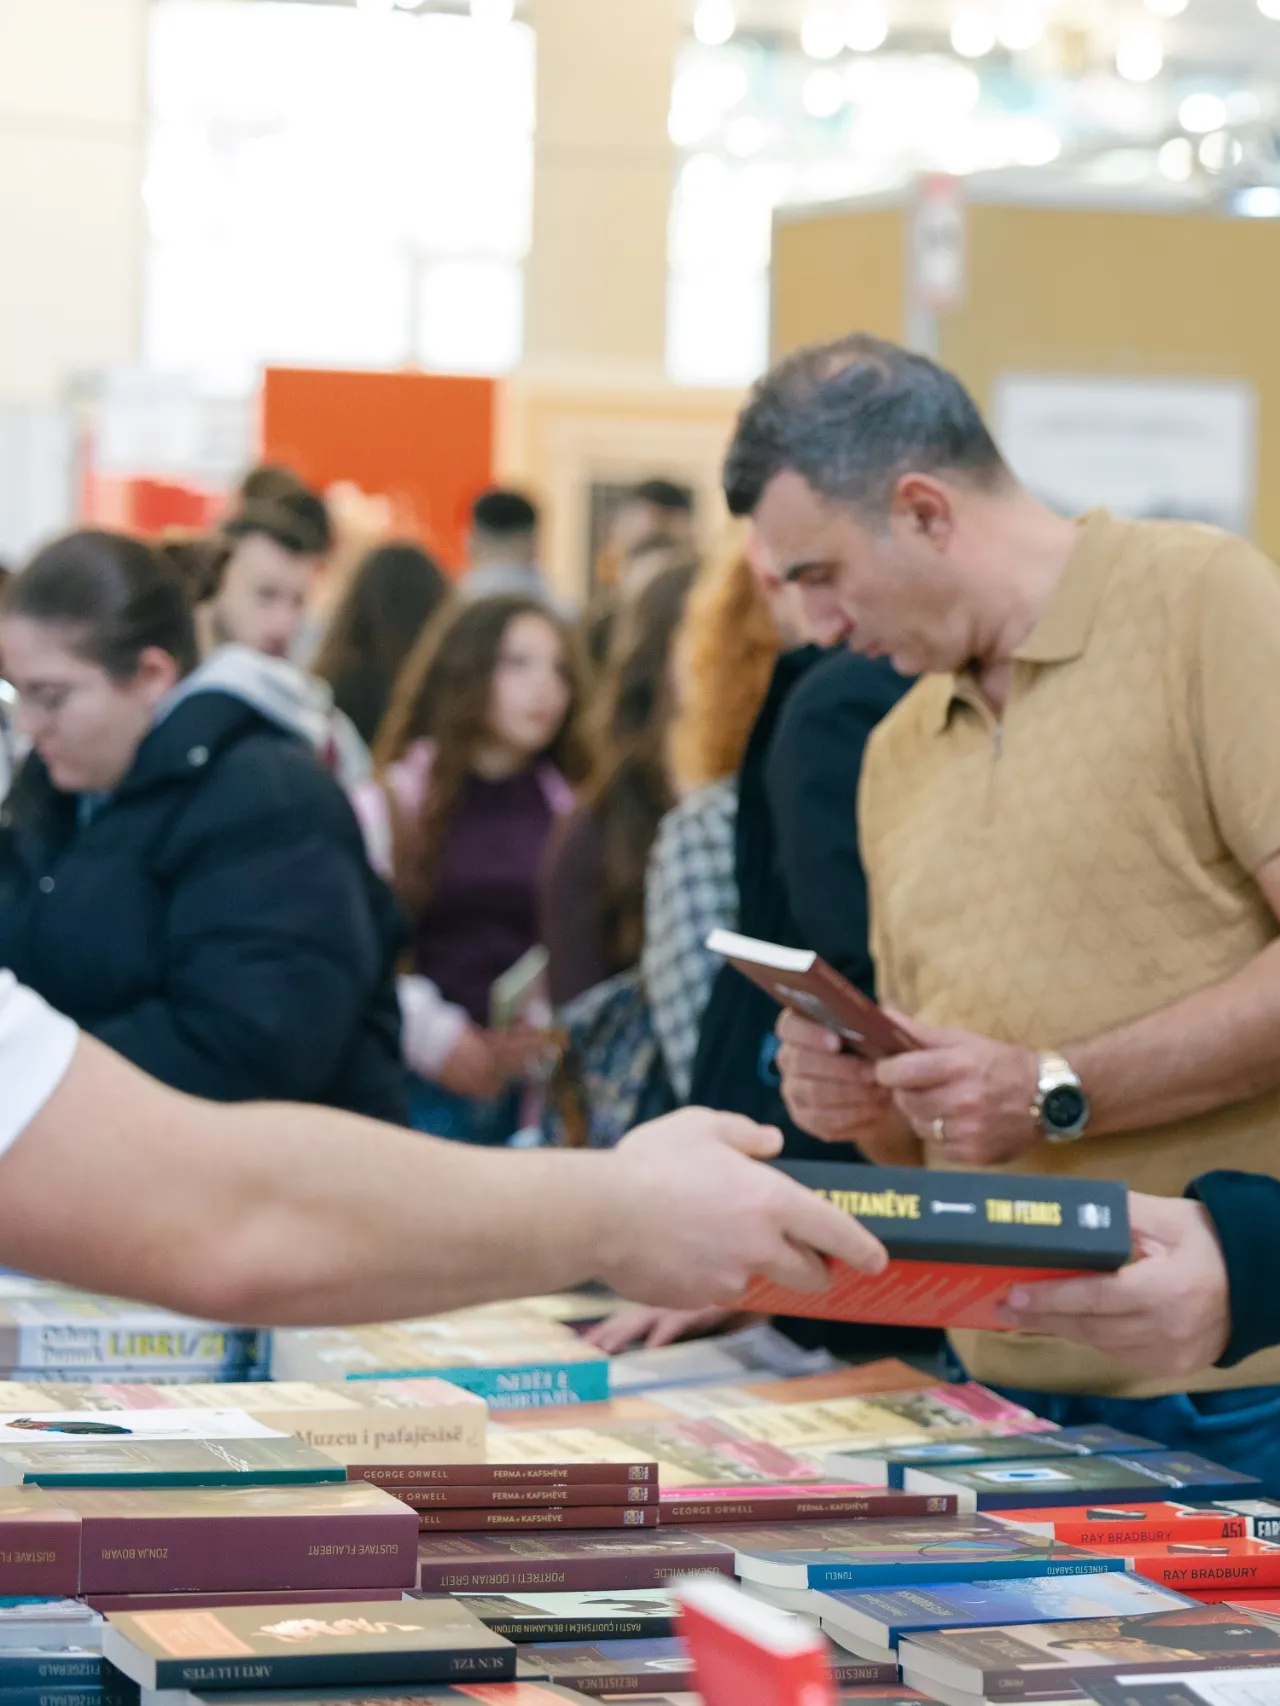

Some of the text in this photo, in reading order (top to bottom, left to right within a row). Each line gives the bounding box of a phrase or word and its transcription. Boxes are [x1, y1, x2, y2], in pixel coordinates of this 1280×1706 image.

[296, 1426, 464, 1449] Muzeu i pafajësisë
[363, 1470, 405, 1479] GEORGE
[408, 1469, 448, 1478] ORWELL
[493, 1470, 520, 1478] FERMA
[407, 1492, 447, 1501] ORWELL
[492, 1491, 520, 1500] FERMA
[671, 1506, 712, 1515] GEORGE
[715, 1504, 754, 1514] ORWELL
[797, 1503, 824, 1512] FERMA
[487, 1515, 514, 1523] FERMA
[1080, 1533, 1104, 1543] RAY
[1108, 1531, 1173, 1543] BRADBURY
[1221, 1521, 1243, 1538] 451
[101, 1548, 168, 1560] ZONJA BOVARI
[308, 1544, 399, 1556] GUSTAVE FLAUBERT
[14, 1552, 56, 1562] GUSTAVE
[653, 1567, 686, 1579] WILDE
[825, 1571, 853, 1580] TUNELI
[1047, 1565, 1108, 1575] ERNESTO SABATO
[1163, 1569, 1187, 1580] RAY
[1191, 1567, 1258, 1579] BRADBURY
[440, 1574, 469, 1586] GREIT
[472, 1573, 510, 1584] DORIAN
[519, 1572, 565, 1583] PORTRETI
[523, 1624, 564, 1633] BENJAMIN
[618, 1623, 641, 1631] RASTI
[38, 1664, 100, 1676] FITZGERALD
[452, 1657, 504, 1671] SUN TZU
[243, 1665, 272, 1677] ARTI
[834, 1667, 879, 1680] ERNESTO
